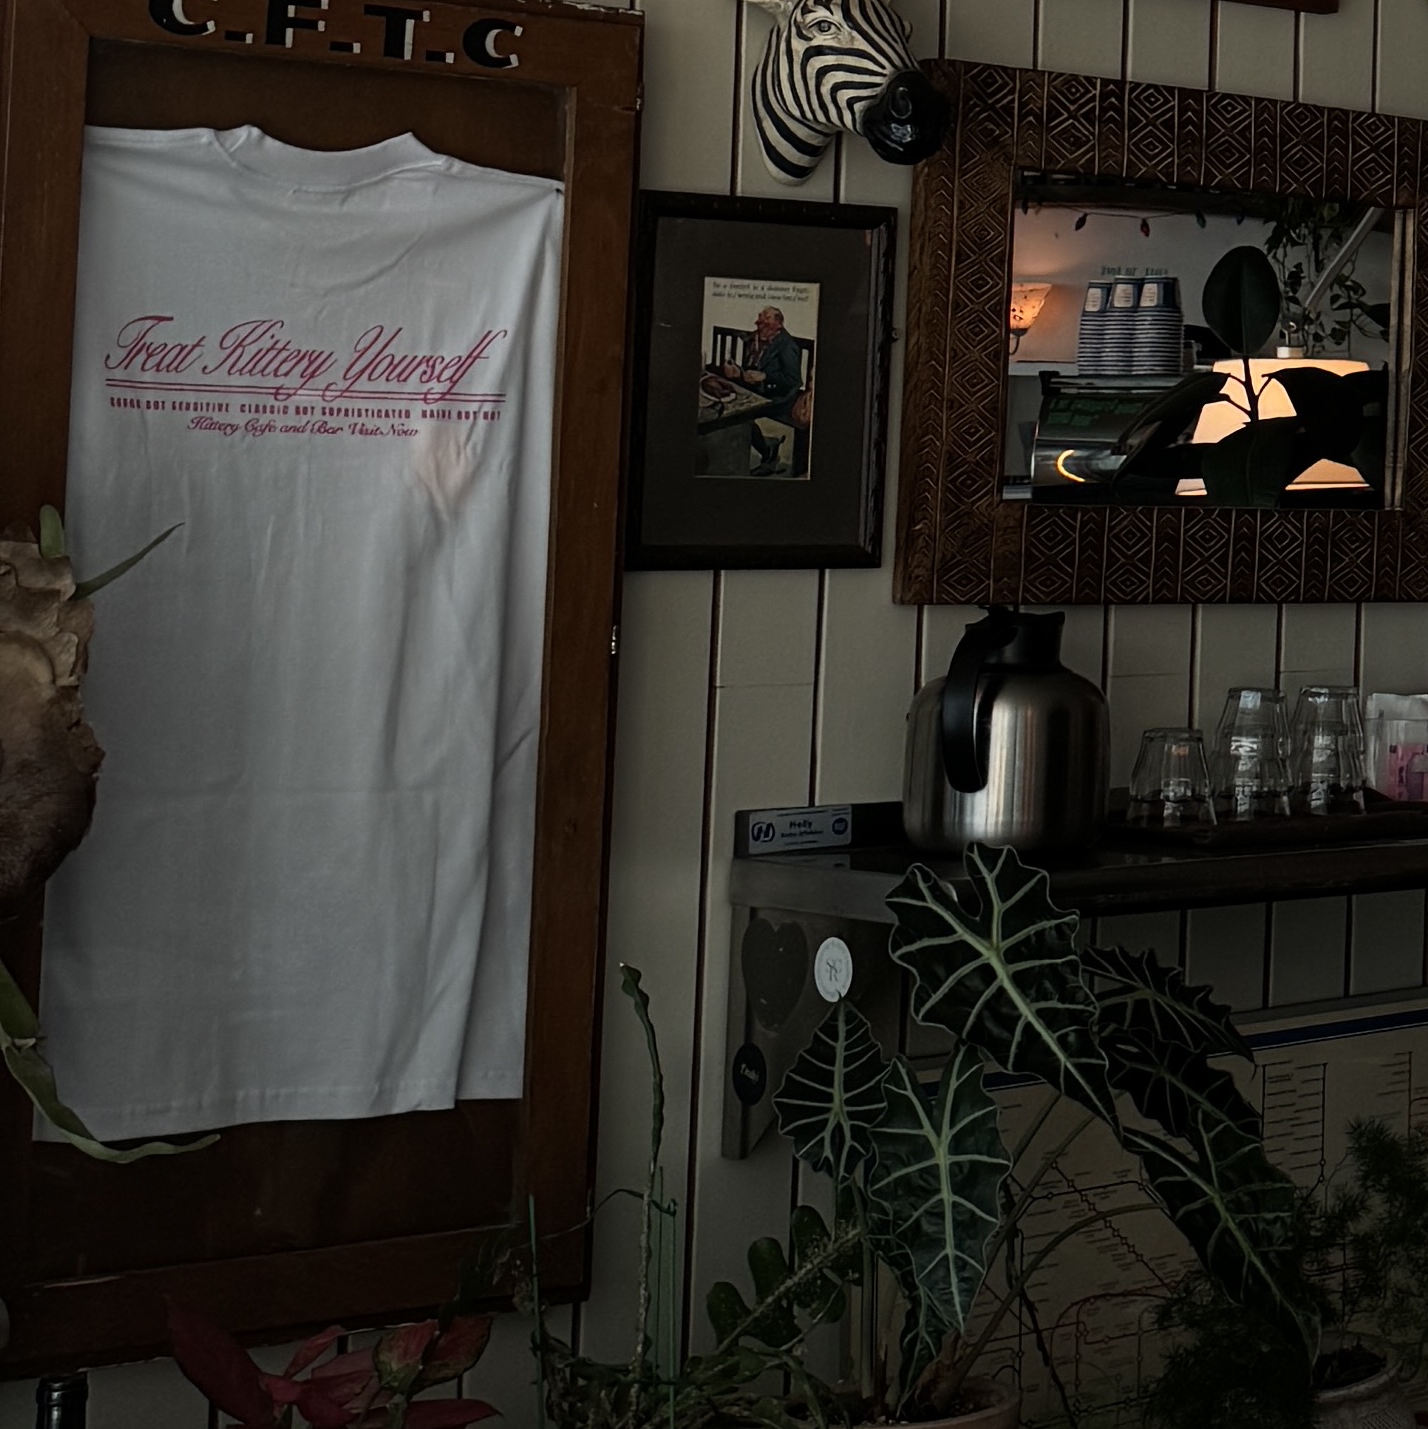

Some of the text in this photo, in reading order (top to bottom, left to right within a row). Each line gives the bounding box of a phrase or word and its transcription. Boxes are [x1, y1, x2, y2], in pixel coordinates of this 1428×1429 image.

[104, 315, 508, 404] Treat Kittery Yourself
